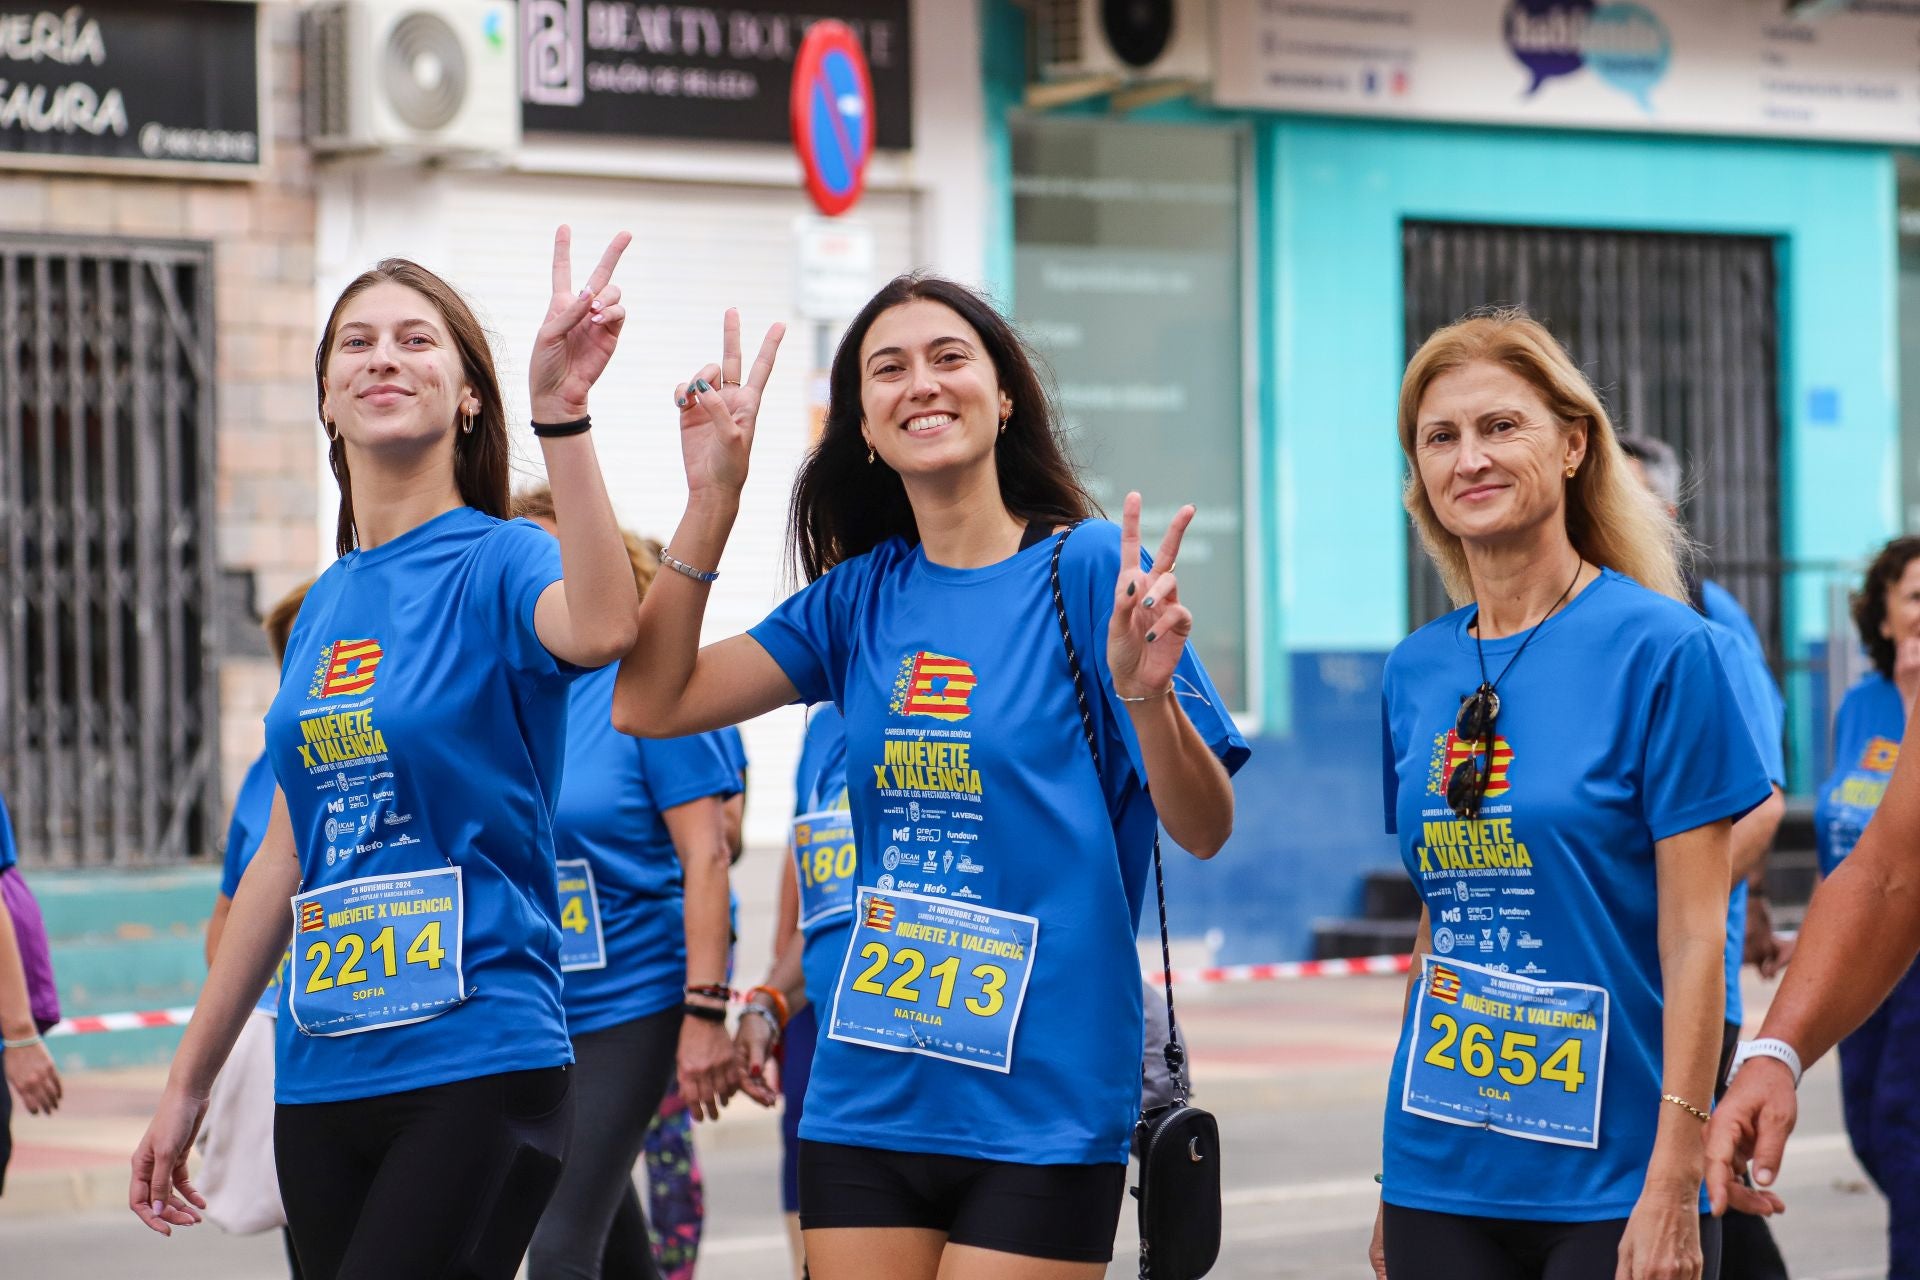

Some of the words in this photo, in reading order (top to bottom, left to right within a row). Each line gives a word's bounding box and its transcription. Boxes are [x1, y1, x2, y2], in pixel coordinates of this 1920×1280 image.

[587, 2, 722, 57] BEAUTY
[300, 708, 373, 743] MUÉVETE
[885, 728, 905, 736] CARRERA
[297, 744, 317, 768] X
[313, 730, 388, 763] VALENCIA
[885, 736, 970, 769] MUÉVETE
[314, 765, 330, 774] FAVOR
[874, 765, 890, 789] X
[892, 765, 982, 795] VALENCIA
[886, 790, 903, 798] FAVOR
[903, 790, 910, 798] DE
[911, 790, 921, 798] LOS
[922, 790, 950, 799] AFECTADOS
[951, 791, 961, 800] POR
[961, 792, 968, 801] LA
[960, 812, 983, 821] VERDAD
[947, 831, 978, 840] fundown
[356, 841, 383, 853] Hero
[1417, 847, 1433, 872] X
[1433, 843, 1533, 869] VALENCIA
[1423, 872, 1428, 880] A
[1429, 870, 1448, 880] FAVOR
[1449, 870, 1456, 878] DE
[1457, 869, 1468, 878] LOS
[359, 883, 394, 894] NOVIEMBRE
[923, 883, 947, 893] Hero
[328, 907, 375, 928] MUÉVETE
[378, 903, 388, 918] X
[390, 897, 453, 916] VALENCIA
[918, 913, 934, 921] CARRERA
[935, 916, 954, 925] POPULAR
[928, 905, 935, 913] 24
[936, 906, 972, 919] NOVIEMBRE
[973, 914, 989, 924] 2024
[895, 921, 947, 945] MUÉVETE
[948, 931, 960, 946] X
[962, 933, 1024, 961] VALENCIA
[305, 921, 445, 994] 2214
[851, 941, 1008, 1017] 2213
[353, 987, 385, 1000] SOFIA
[894, 1008, 943, 1026] NATALIA
[1462, 994, 1511, 1020] MUÉVETE
[1514, 1006, 1524, 1023] X
[1528, 1008, 1596, 1030] VALENCIA
[1423, 1012, 1586, 1093] 2654
[1479, 1086, 1510, 1101] LOLA
